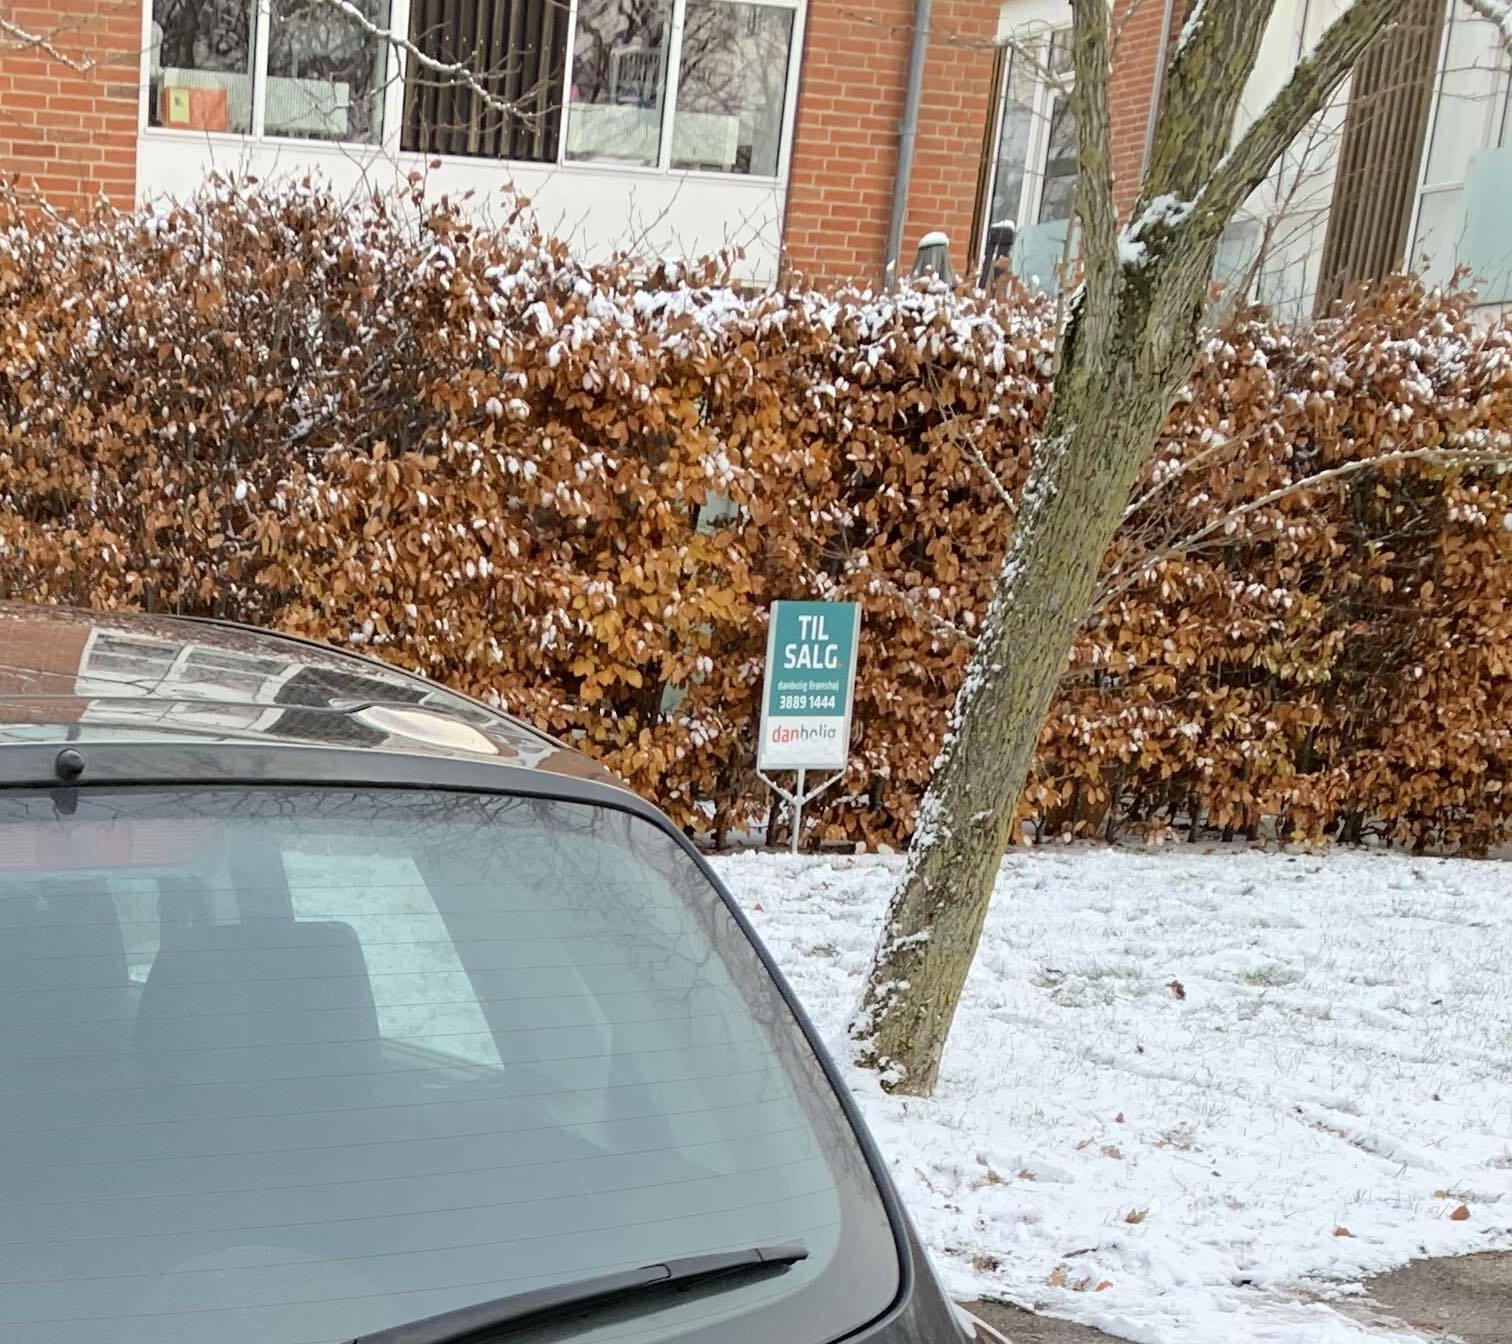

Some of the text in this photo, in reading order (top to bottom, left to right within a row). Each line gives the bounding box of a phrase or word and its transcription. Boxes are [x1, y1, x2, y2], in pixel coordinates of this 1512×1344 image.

[798, 615, 829, 641] TIL
[784, 643, 839, 669] SALG
[779, 695, 836, 709] 3889 1444
